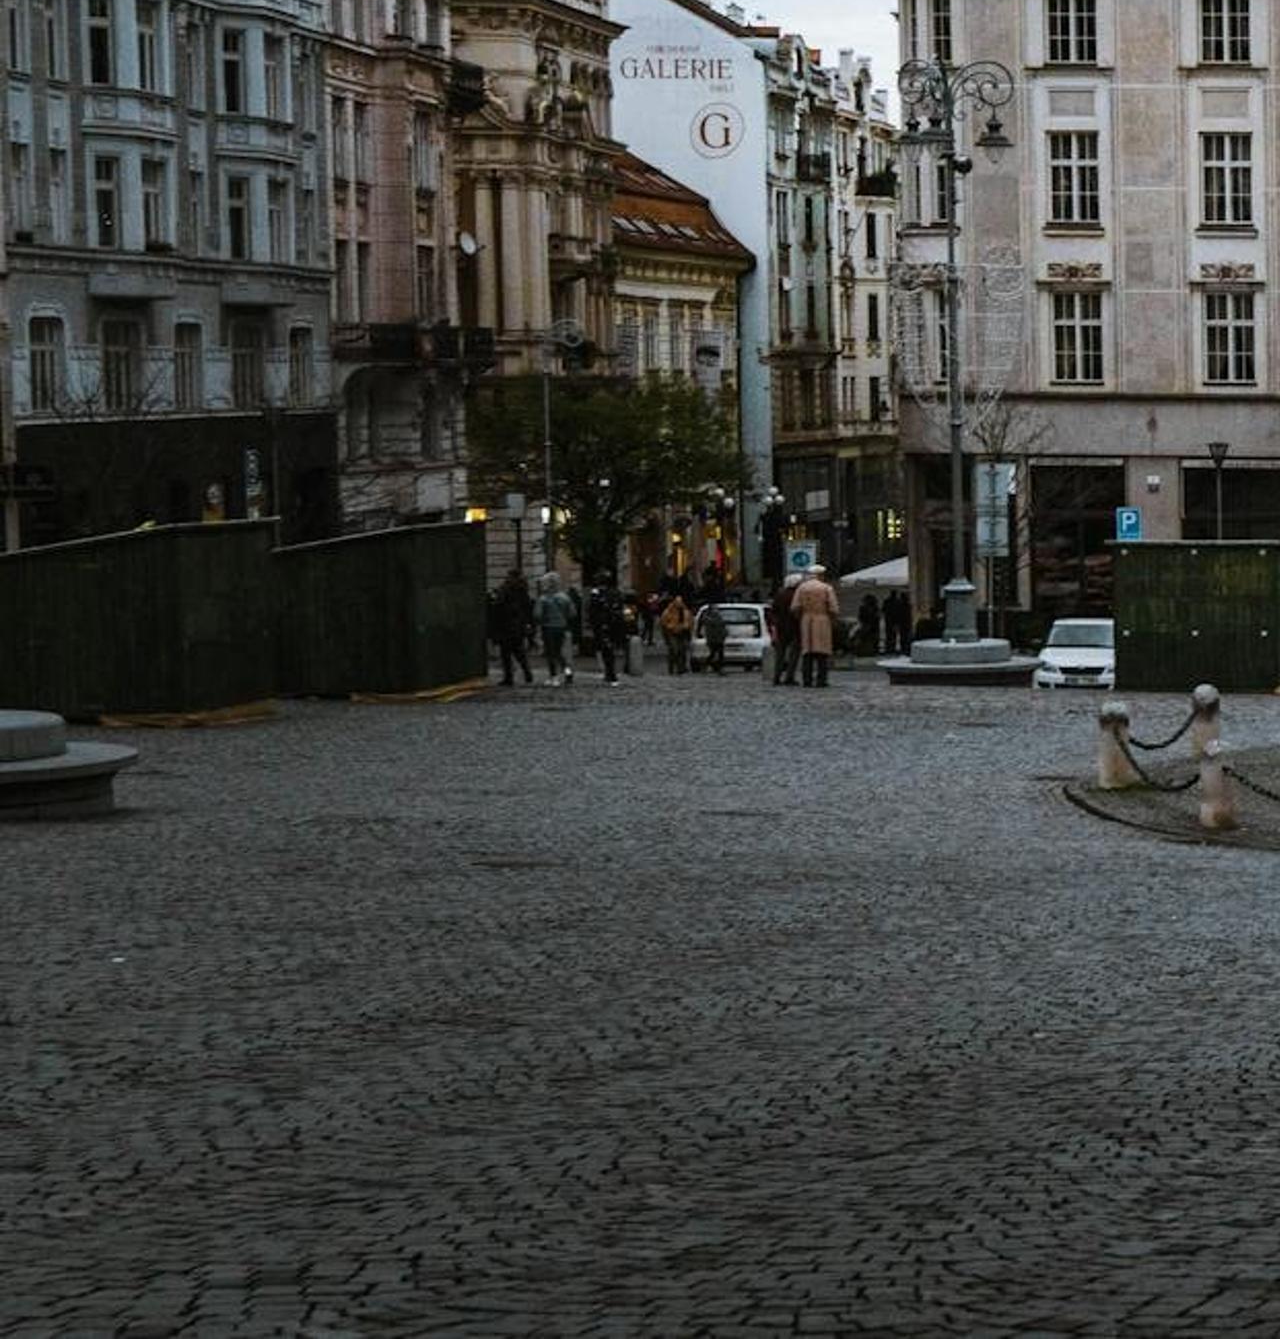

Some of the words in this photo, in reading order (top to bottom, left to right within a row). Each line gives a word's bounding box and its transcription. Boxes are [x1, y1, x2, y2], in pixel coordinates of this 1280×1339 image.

[620, 57, 733, 79] GALERIE
[700, 113, 731, 149] G
[1122, 512, 1137, 532] P
